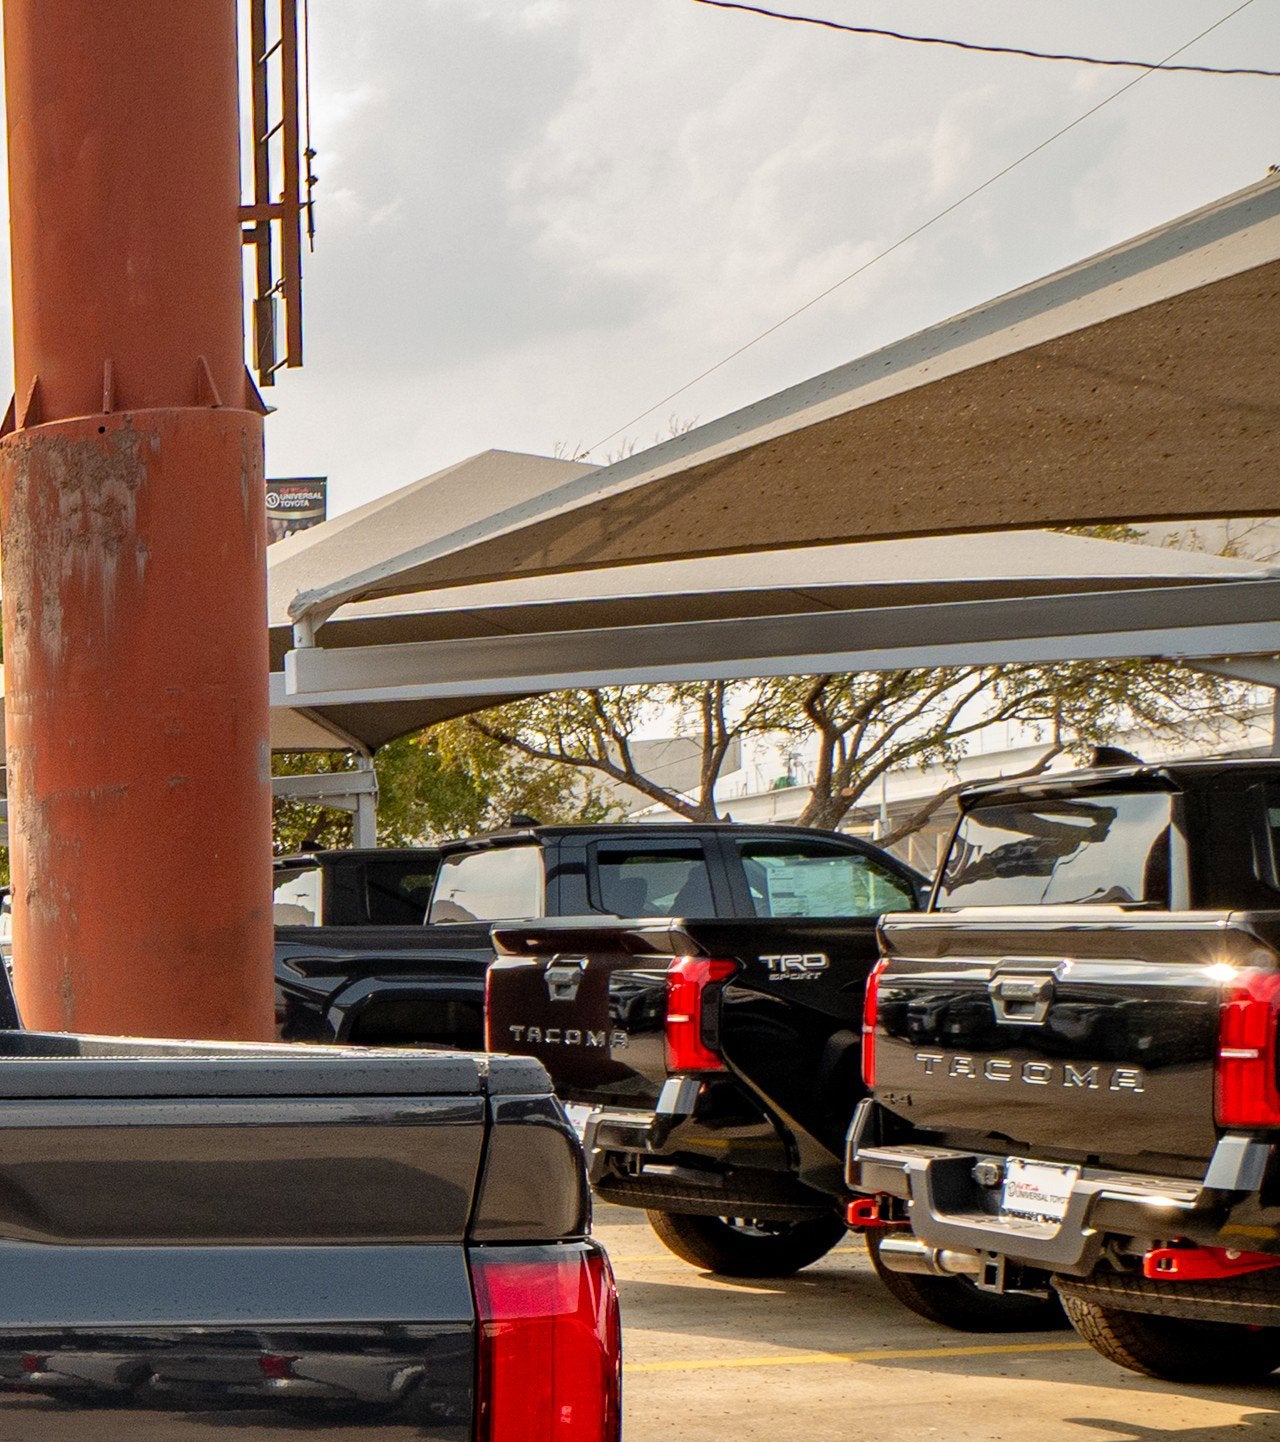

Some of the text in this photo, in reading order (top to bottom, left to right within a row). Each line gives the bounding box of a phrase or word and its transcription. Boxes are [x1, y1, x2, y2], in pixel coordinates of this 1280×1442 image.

[280, 492, 323, 500] UNIVERSAL
[758, 953, 827, 972] TRD
[509, 1025, 629, 1048] TACOMA
[915, 1052, 1145, 1092] TACOMA
